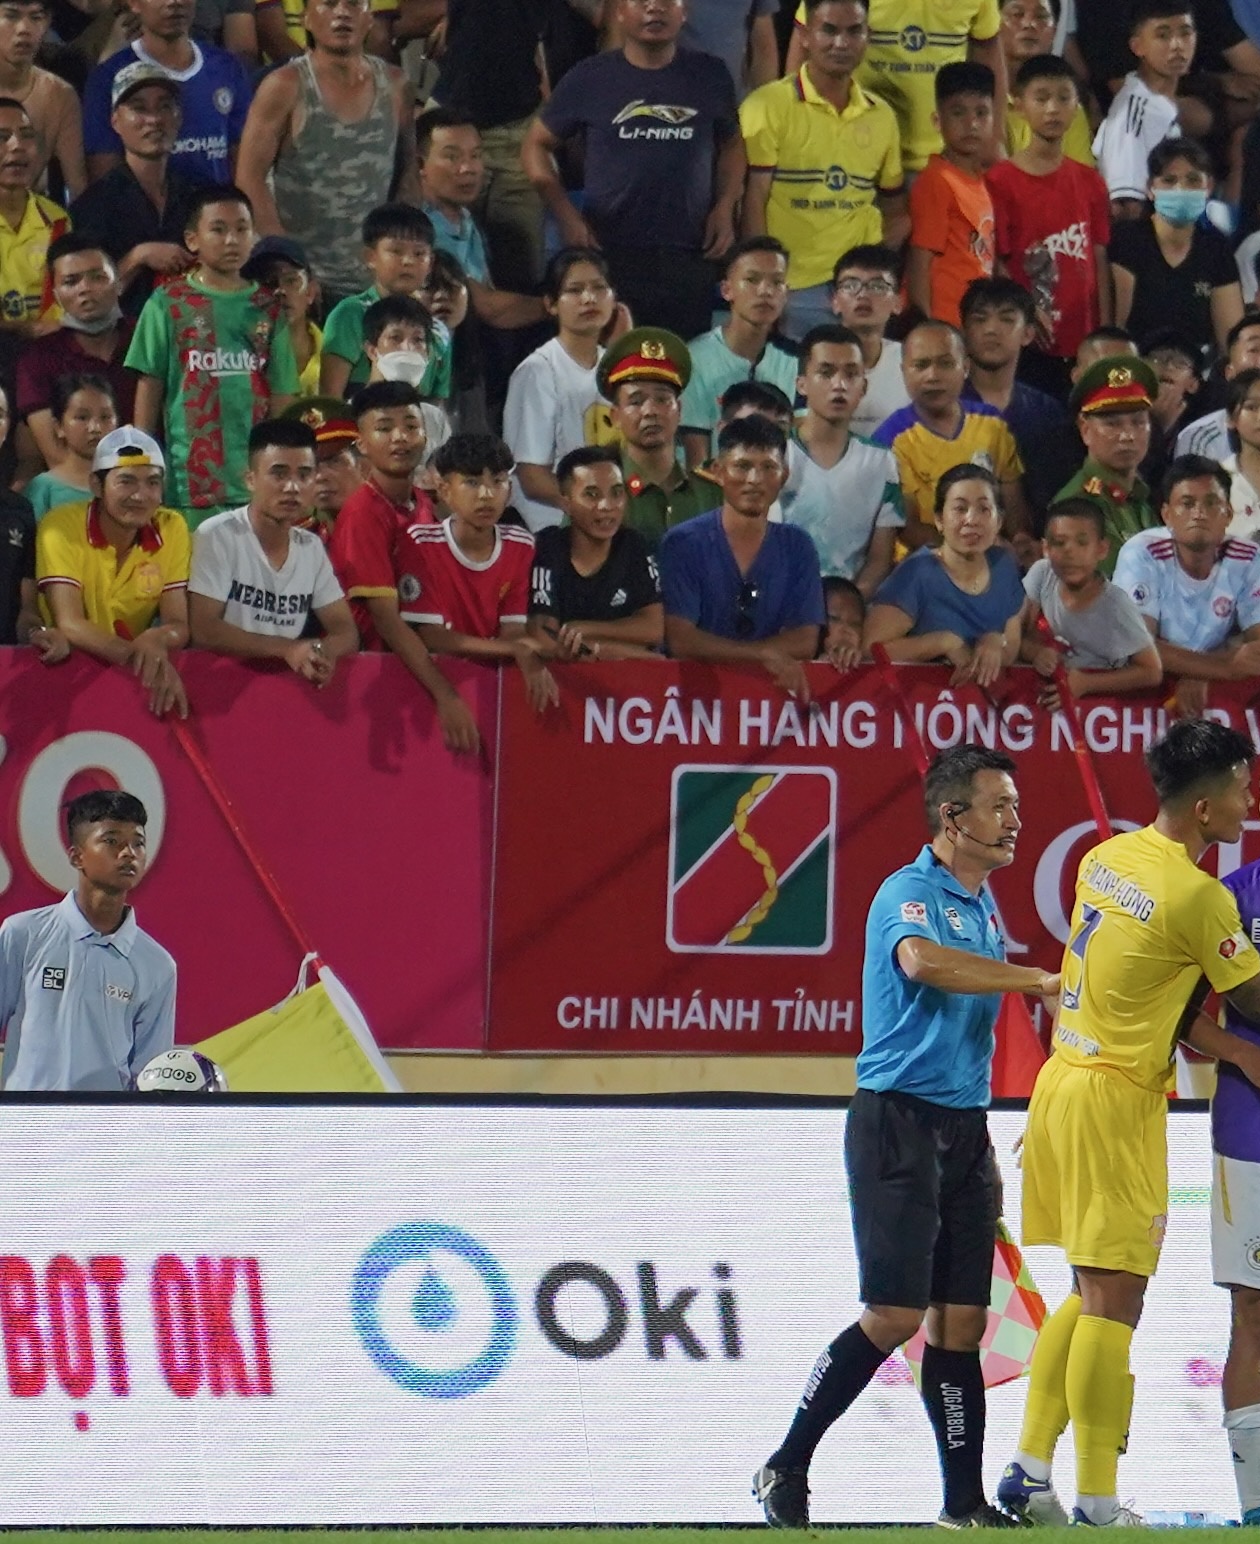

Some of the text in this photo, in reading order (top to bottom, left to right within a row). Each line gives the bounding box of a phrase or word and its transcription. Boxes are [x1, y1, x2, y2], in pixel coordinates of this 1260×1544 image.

[618, 126, 694, 140] LI-NING
[584, 686, 721, 746] NGÂN
[739, 689, 877, 749] HÀNG
[1050, 705, 1232, 753] NGHIP
[556, 988, 854, 1032] CHI NHÁNH TỈNH
[151, 1254, 273, 1398] OKI
[535, 1261, 743, 1361] Oki
[940, 1381, 966, 1450] JOGARBOLA
